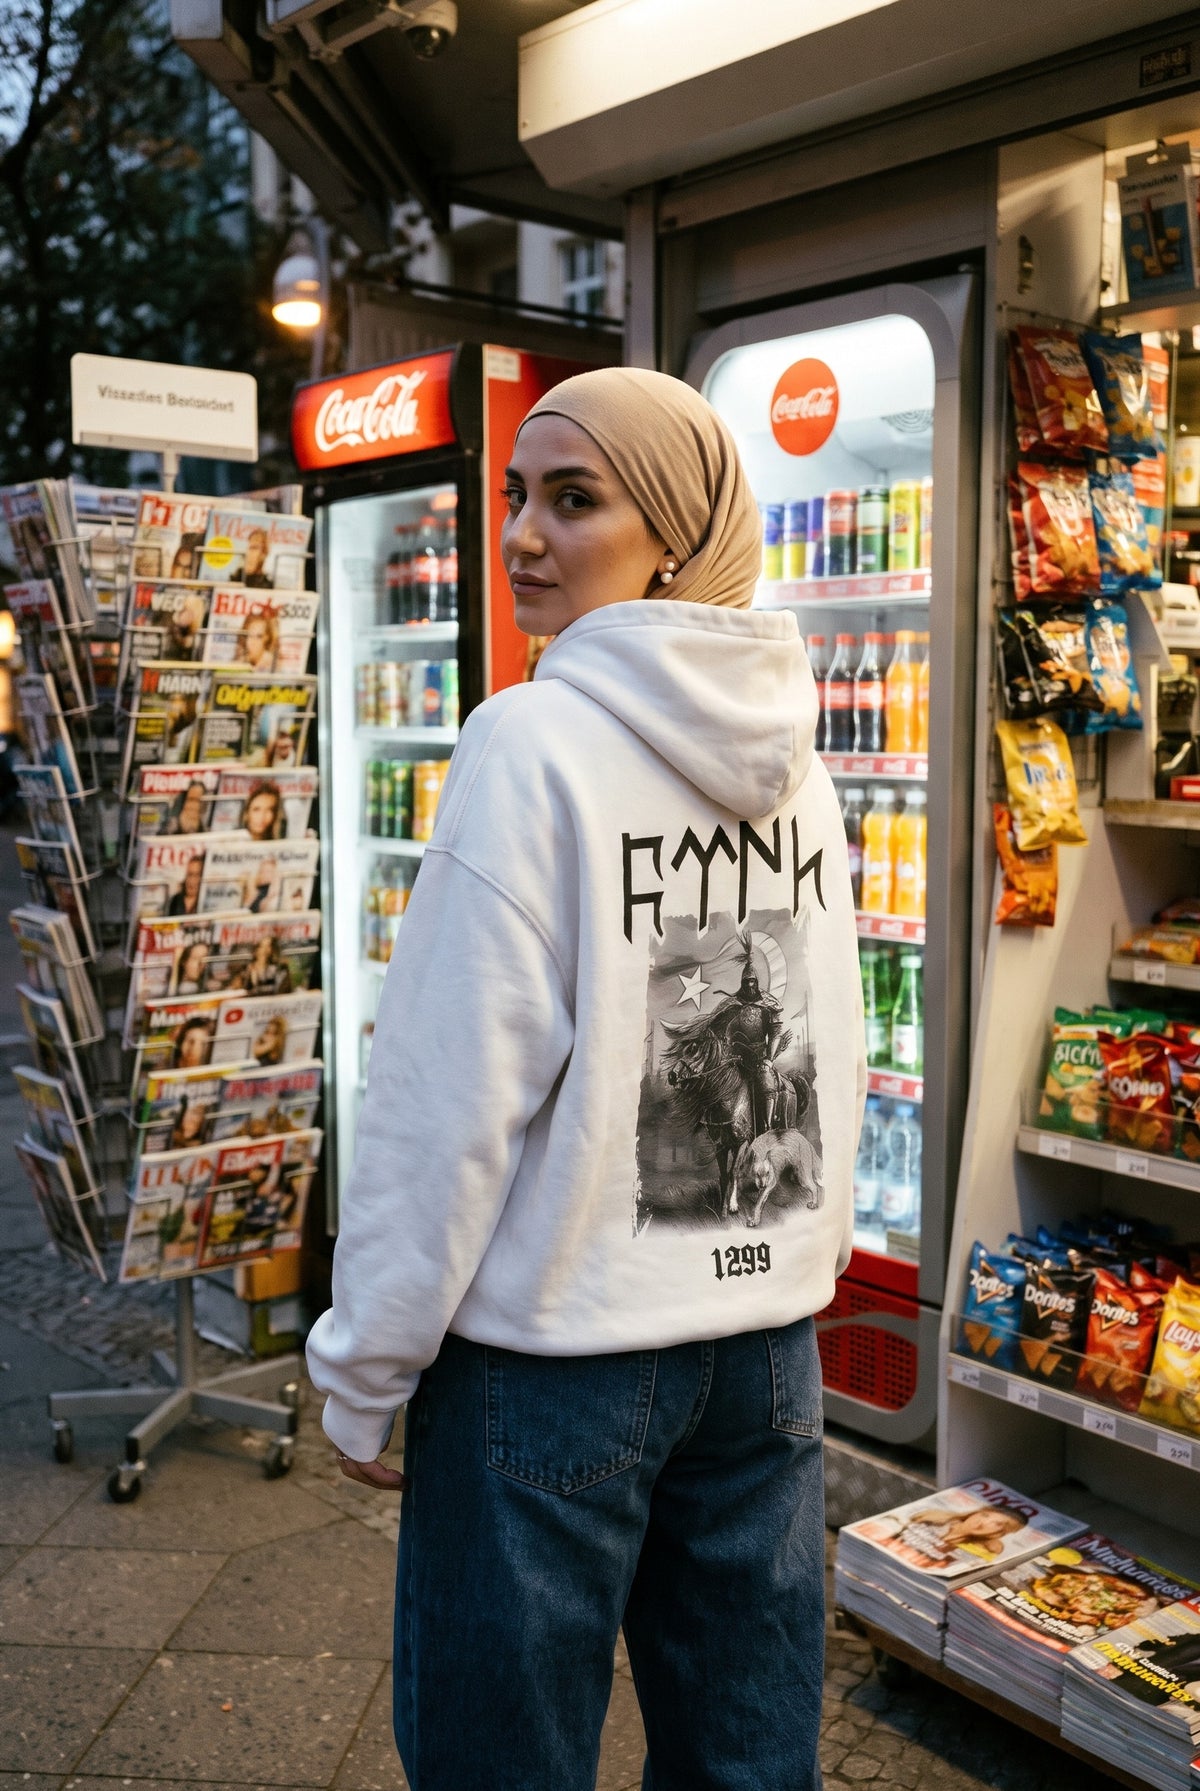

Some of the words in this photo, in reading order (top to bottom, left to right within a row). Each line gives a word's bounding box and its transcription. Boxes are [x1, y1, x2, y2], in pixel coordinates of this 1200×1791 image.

[711, 1241, 771, 1281] 1299
[1024, 1284, 1076, 1313] Doritos
[1090, 1299, 1139, 1326] Doritos
